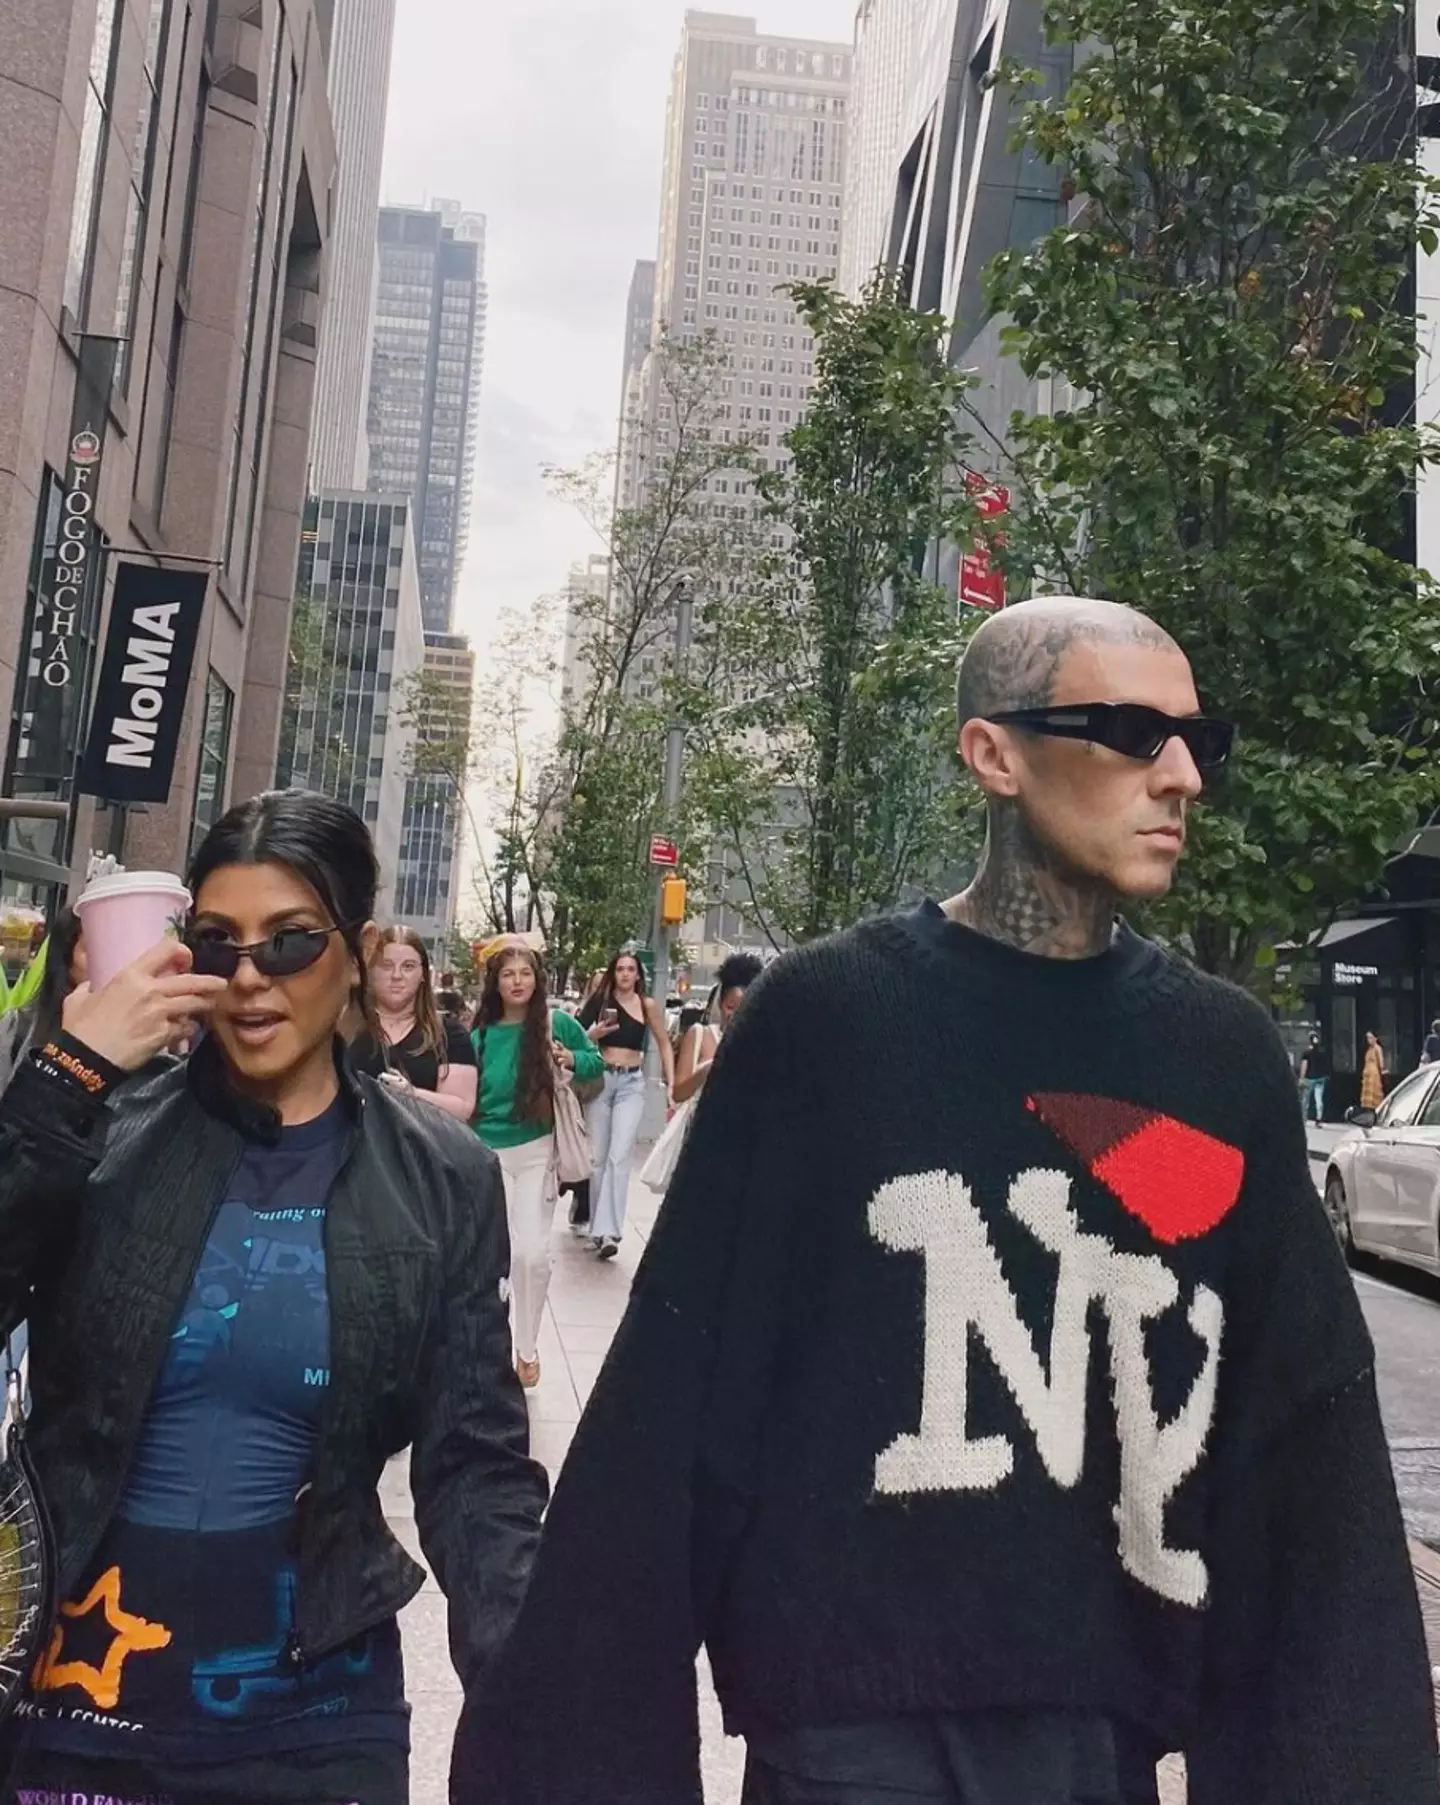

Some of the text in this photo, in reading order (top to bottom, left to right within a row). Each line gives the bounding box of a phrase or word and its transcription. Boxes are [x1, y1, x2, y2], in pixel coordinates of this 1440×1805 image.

[59, 468, 91, 565] FOGO
[56, 567, 85, 585] DE
[106, 601, 182, 769] MoMA
[1335, 963, 1378, 974] Museum
[1335, 973, 1363, 984] Store
[867, 1168, 1224, 1608] NY
